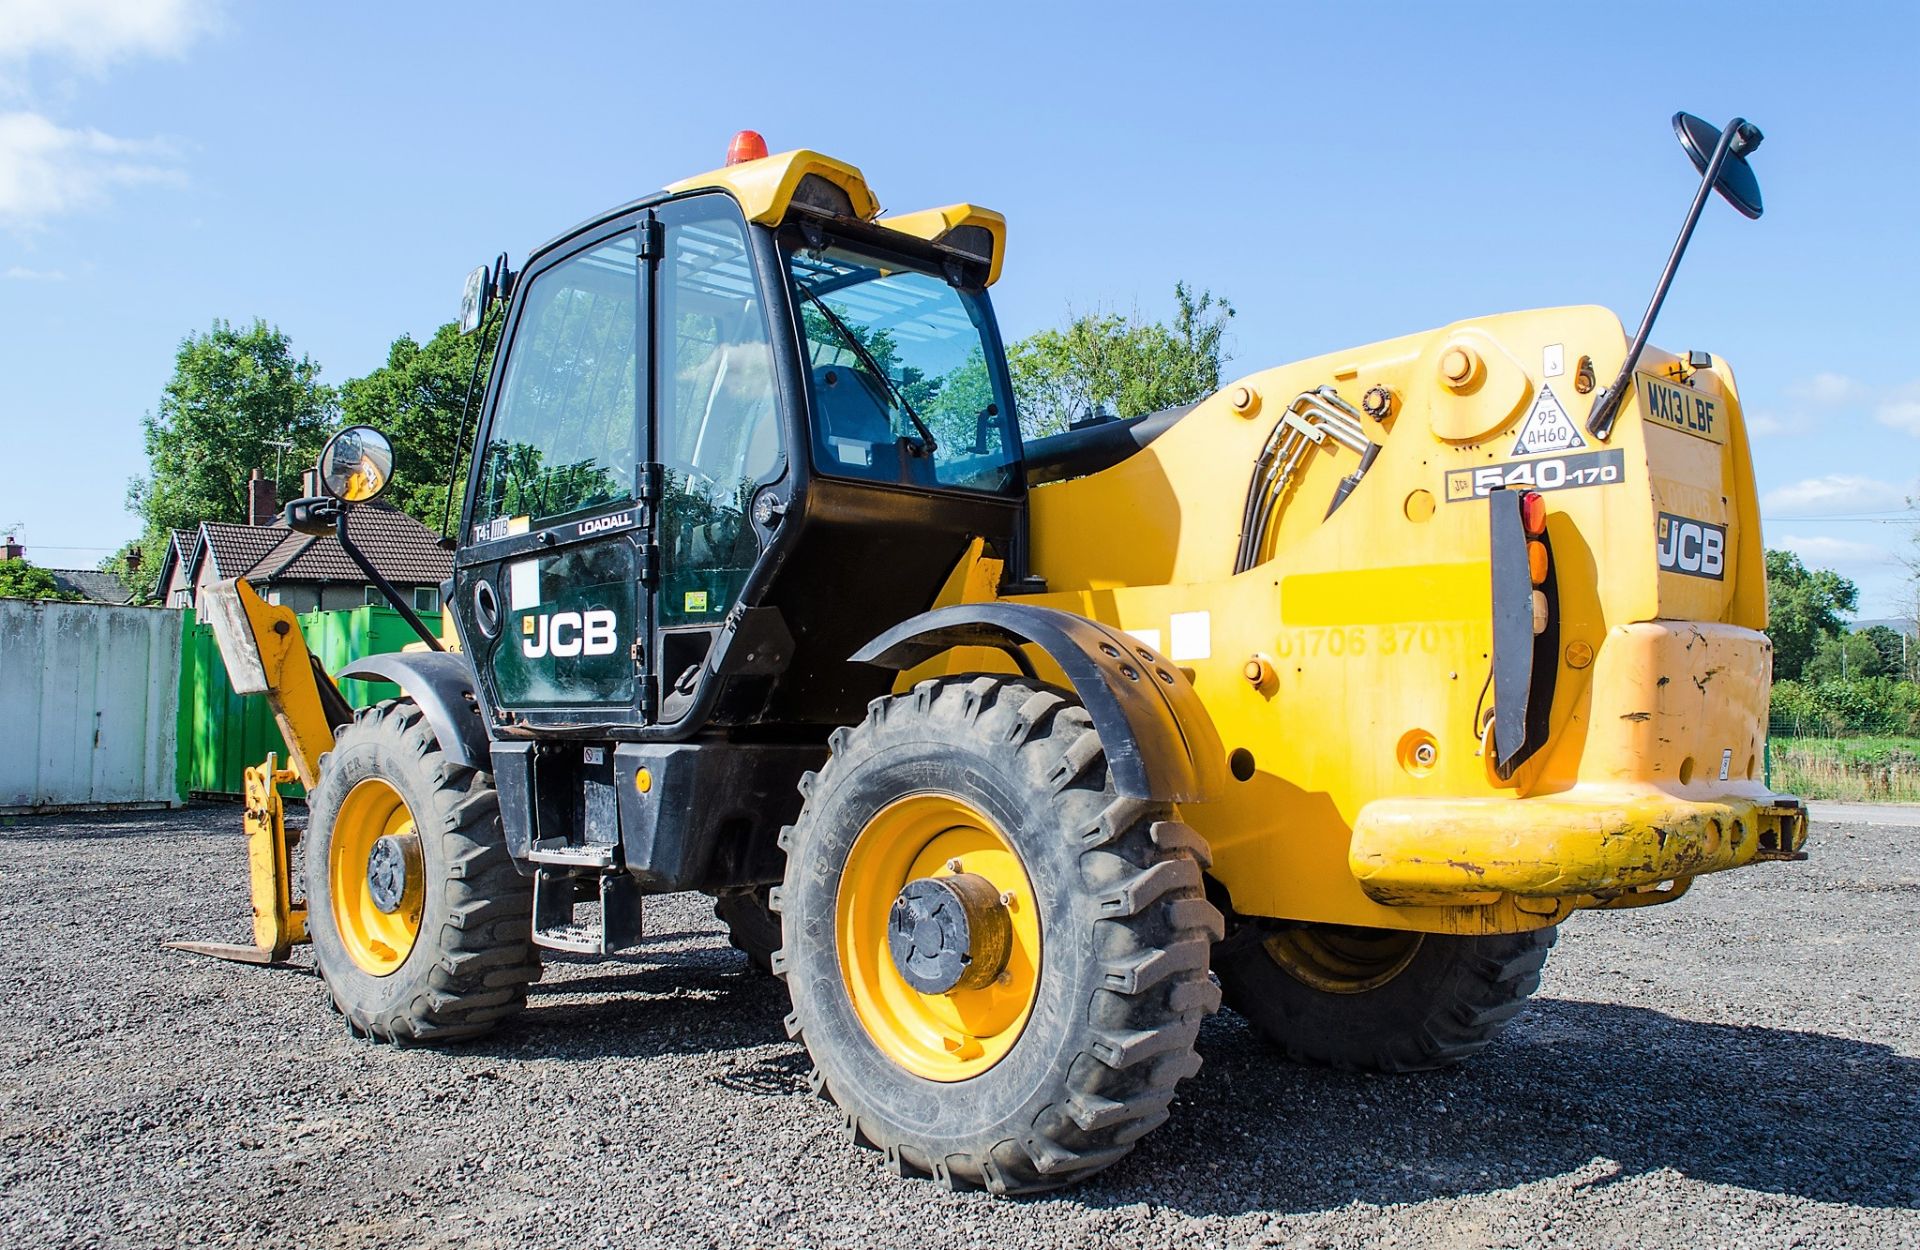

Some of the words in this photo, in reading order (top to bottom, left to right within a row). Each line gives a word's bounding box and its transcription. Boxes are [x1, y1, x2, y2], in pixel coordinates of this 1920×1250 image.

[1538, 409, 1557, 426] 95
[1647, 381, 1683, 425] MX13
[1685, 394, 1714, 434] LBF
[578, 512, 633, 536] LOADALL
[1657, 519, 1724, 576] JCB
[522, 609, 618, 659] JCB
